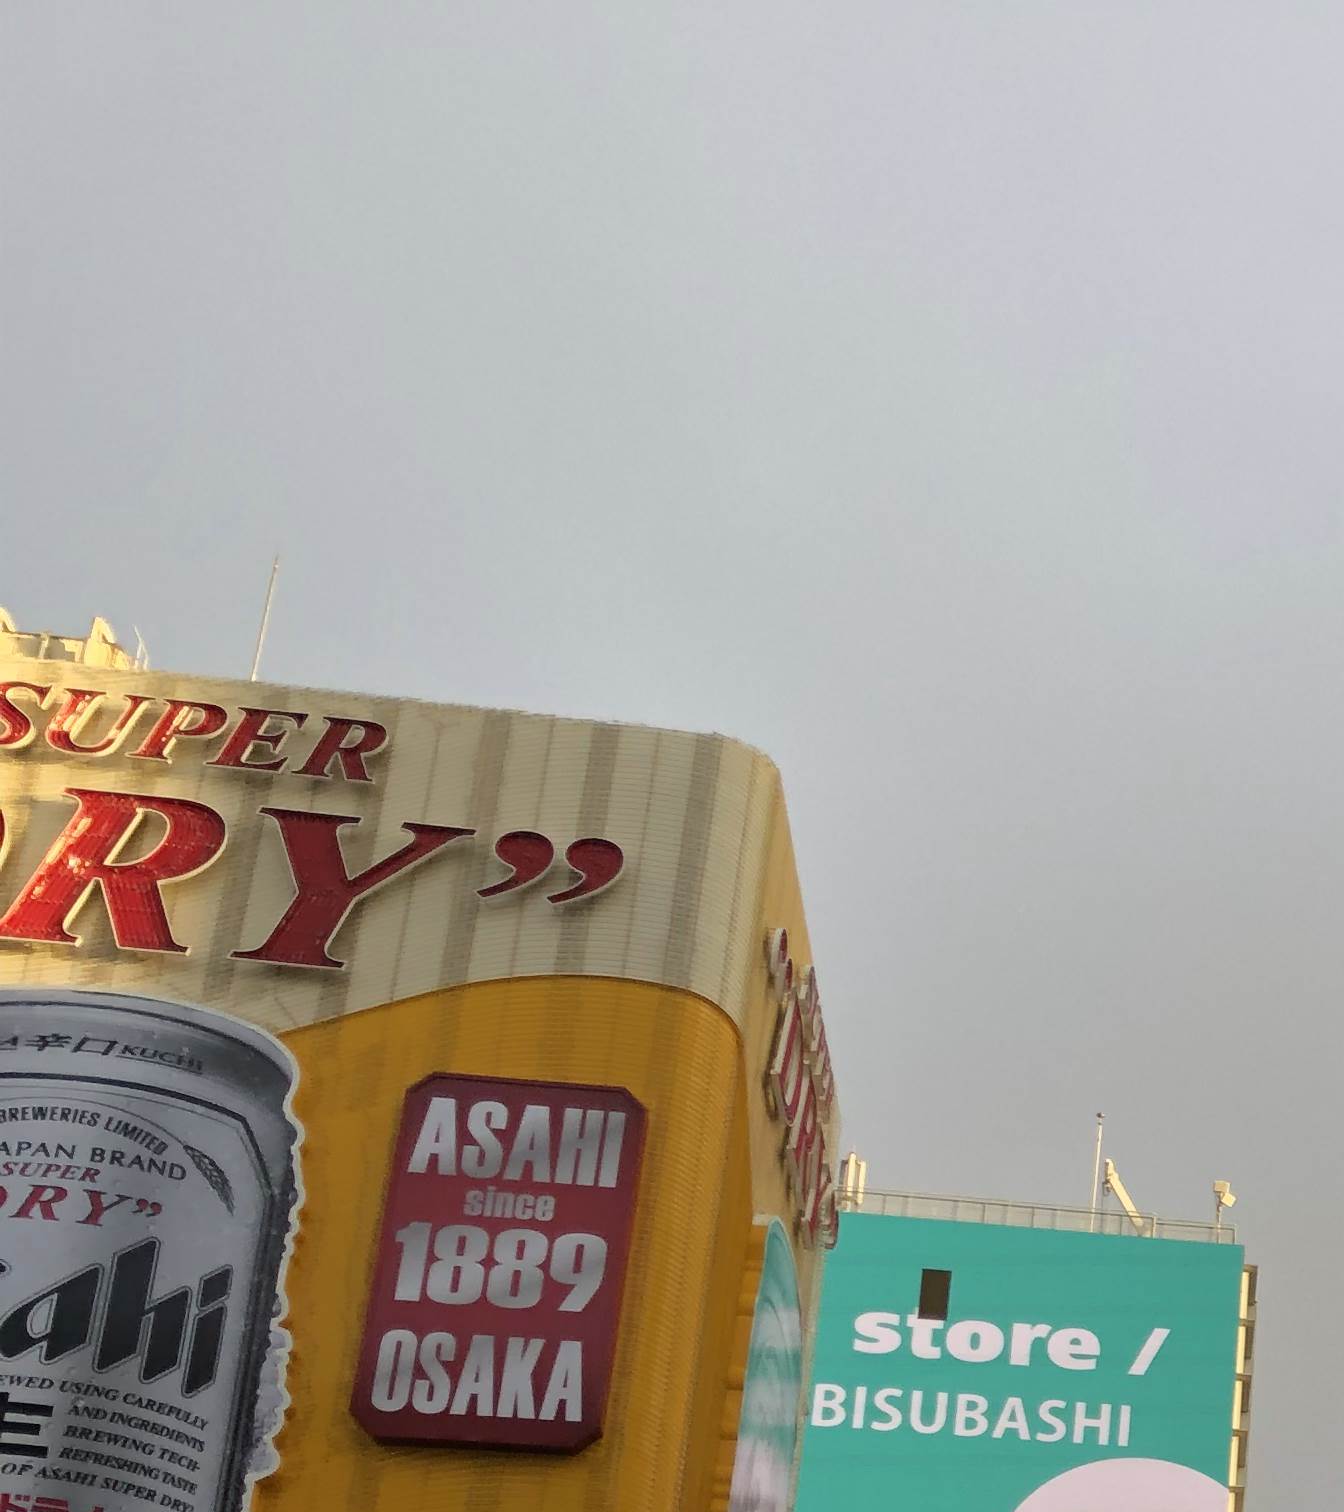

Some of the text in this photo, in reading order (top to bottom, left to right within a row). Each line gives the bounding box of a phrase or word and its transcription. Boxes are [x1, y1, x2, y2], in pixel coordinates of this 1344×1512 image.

[0, 680, 390, 784] SUPER
[0, 786, 625, 970] RY”
[103, 1116, 169, 1157] LIMITED
[407, 1095, 626, 1190] ASAHI
[0, 1160, 102, 1184] SUPER
[89, 1147, 188, 1182] BRAND
[463, 1187, 556, 1223] since
[393, 1222, 609, 1314] 1889
[0, 1234, 234, 1400] ahi
[852, 1308, 1102, 1373] store
[371, 1328, 586, 1424] OSAKA
[59, 1379, 119, 1402] USING
[122, 1391, 209, 1432] CAREFULLY
[66, 1404, 206, 1453] AND INGREDIENTS
[810, 1382, 1133, 1448] BISUBASHI
[62, 1424, 155, 1456] BREWING
[1, 1462, 33, 1476] OF
[35, 1465, 98, 1487] ASAHI
[100, 1477, 158, 1503] SUPER
[59, 1447, 198, 1496] REFRESHING TASTE
